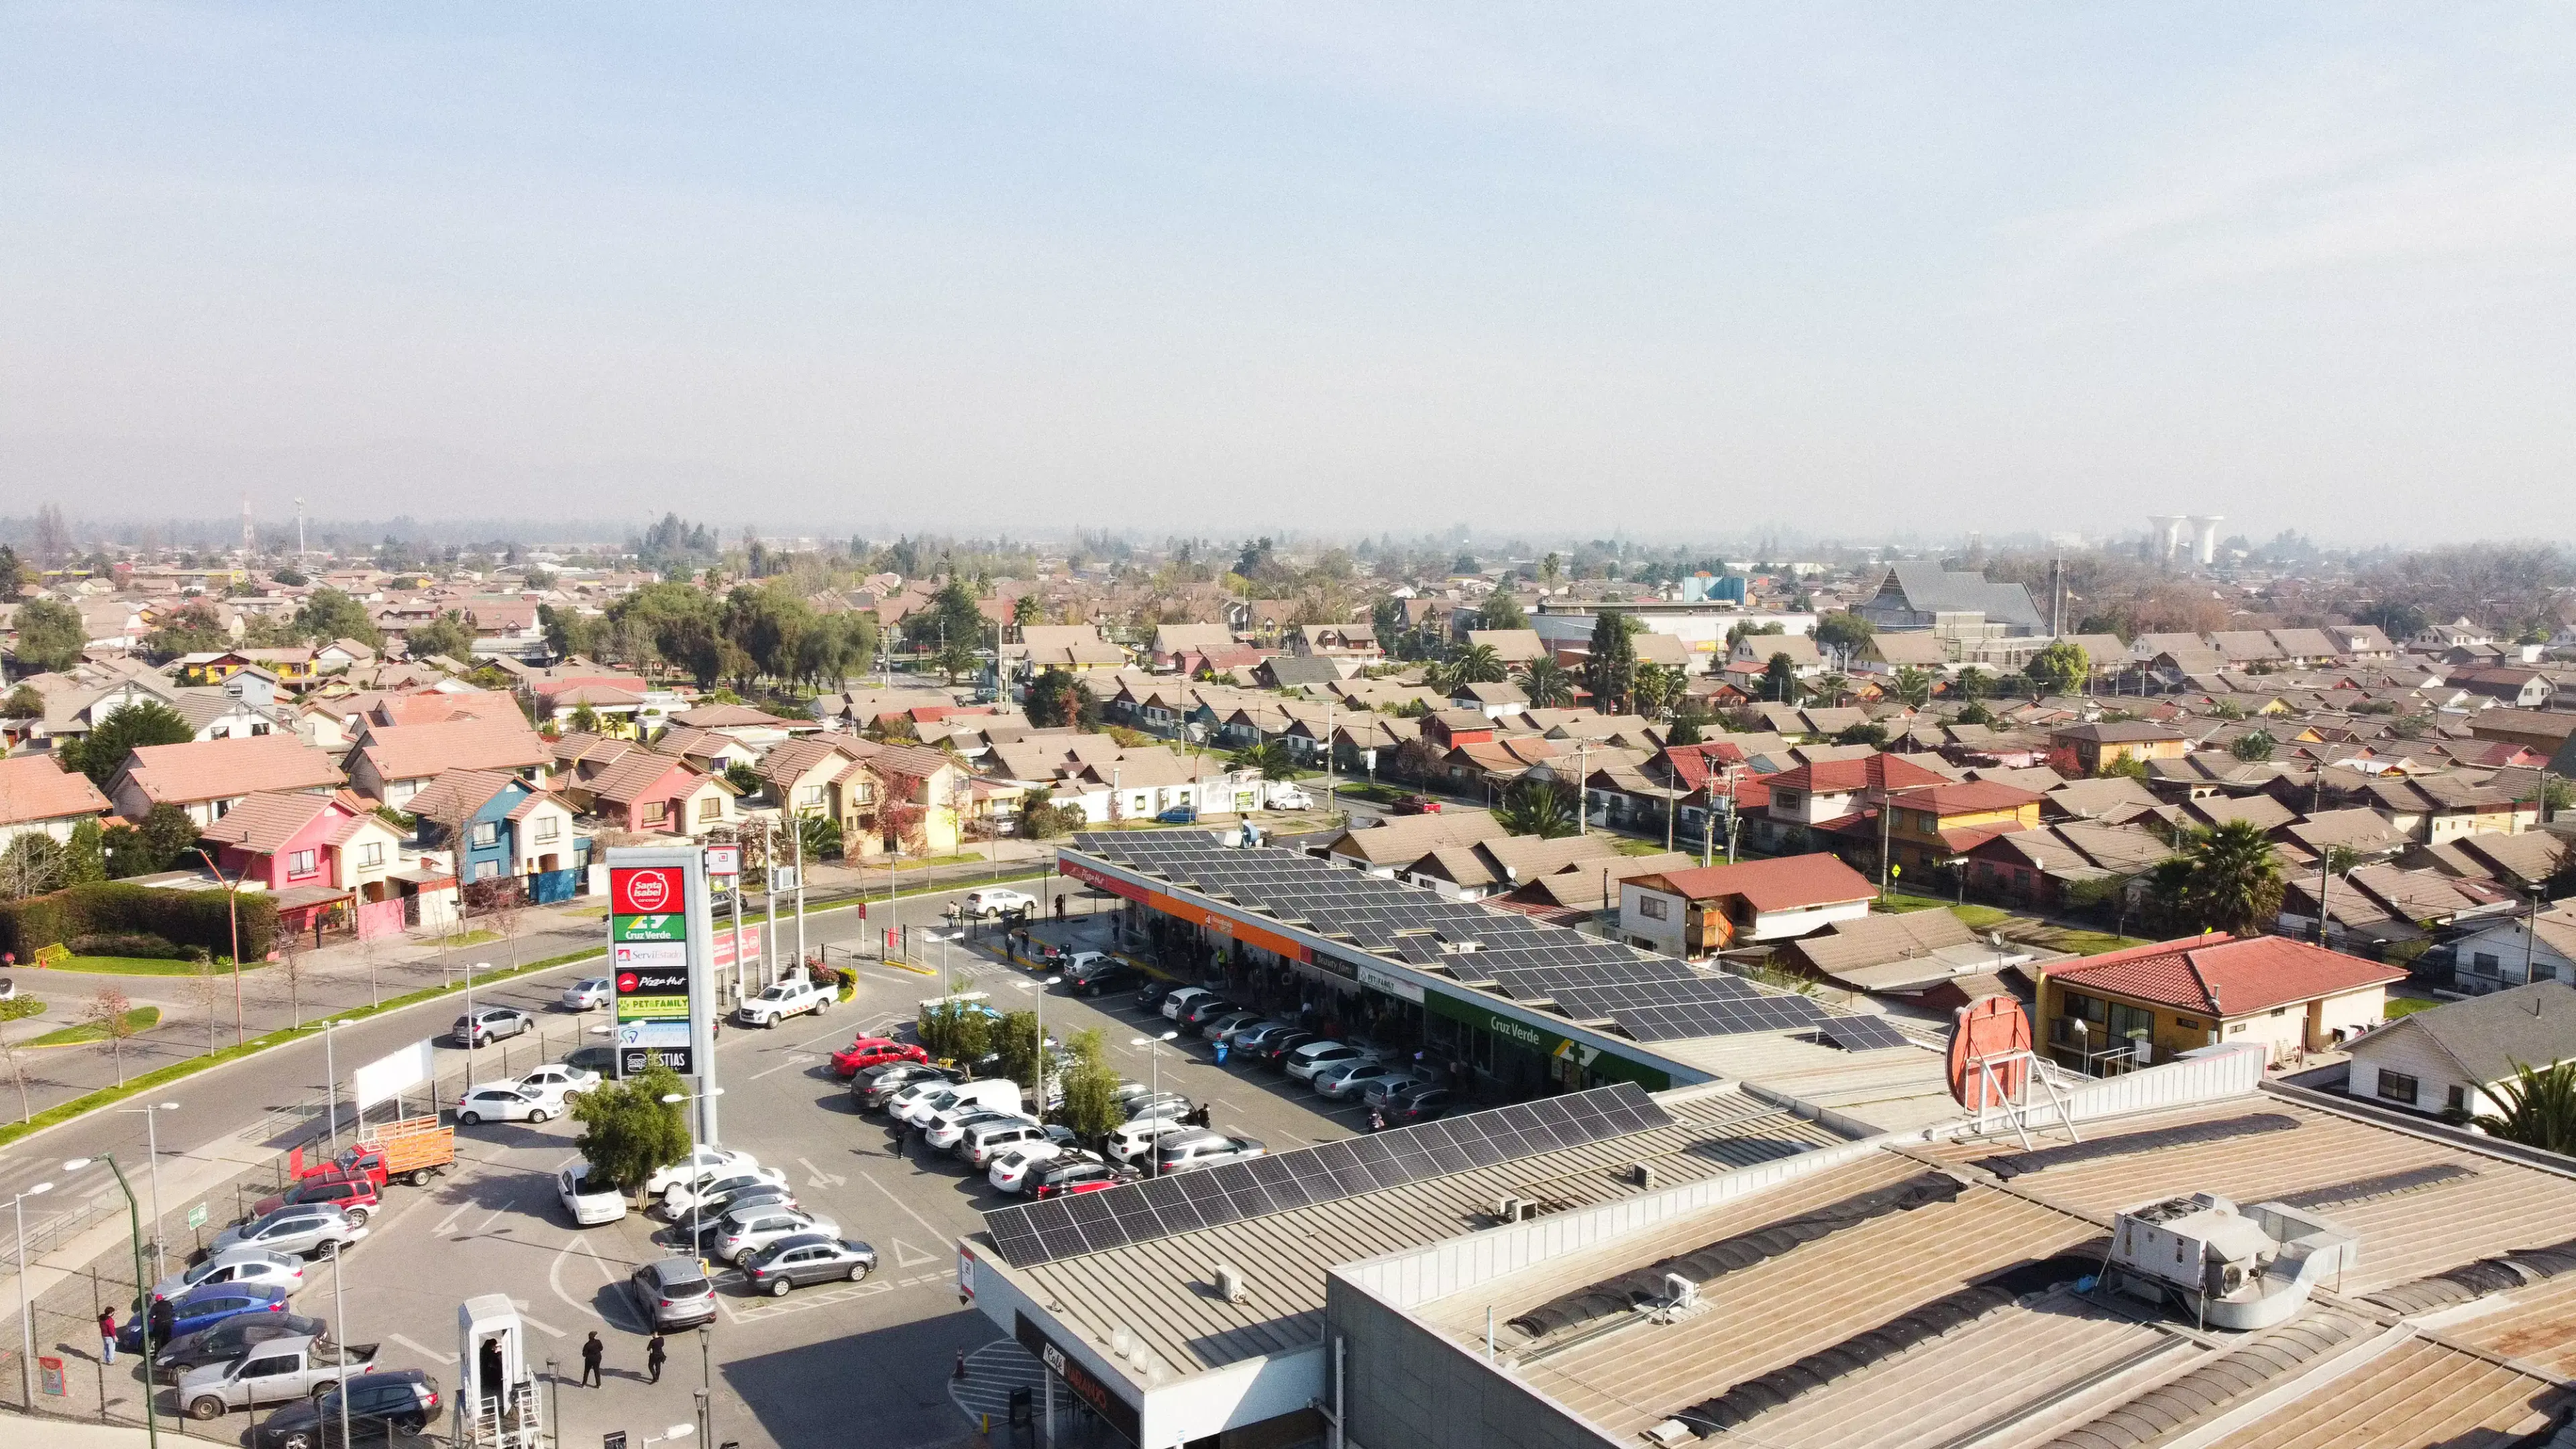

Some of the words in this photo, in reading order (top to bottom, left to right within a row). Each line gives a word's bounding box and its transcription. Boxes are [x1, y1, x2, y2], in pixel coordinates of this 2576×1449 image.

[635, 881, 662, 890] Santa
[634, 888, 661, 896] Isabel
[625, 931, 644, 940] Cruz
[644, 930, 672, 939] Verde
[1317, 953, 1337, 971] Beauty
[1338, 961, 1352, 974] fans
[639, 977, 666, 987] Pizza
[665, 976, 687, 986] Hut
[1491, 1016, 1511, 1035] Cruz
[1511, 1022, 1540, 1044] Verde
[1046, 1345, 1063, 1371] Café
